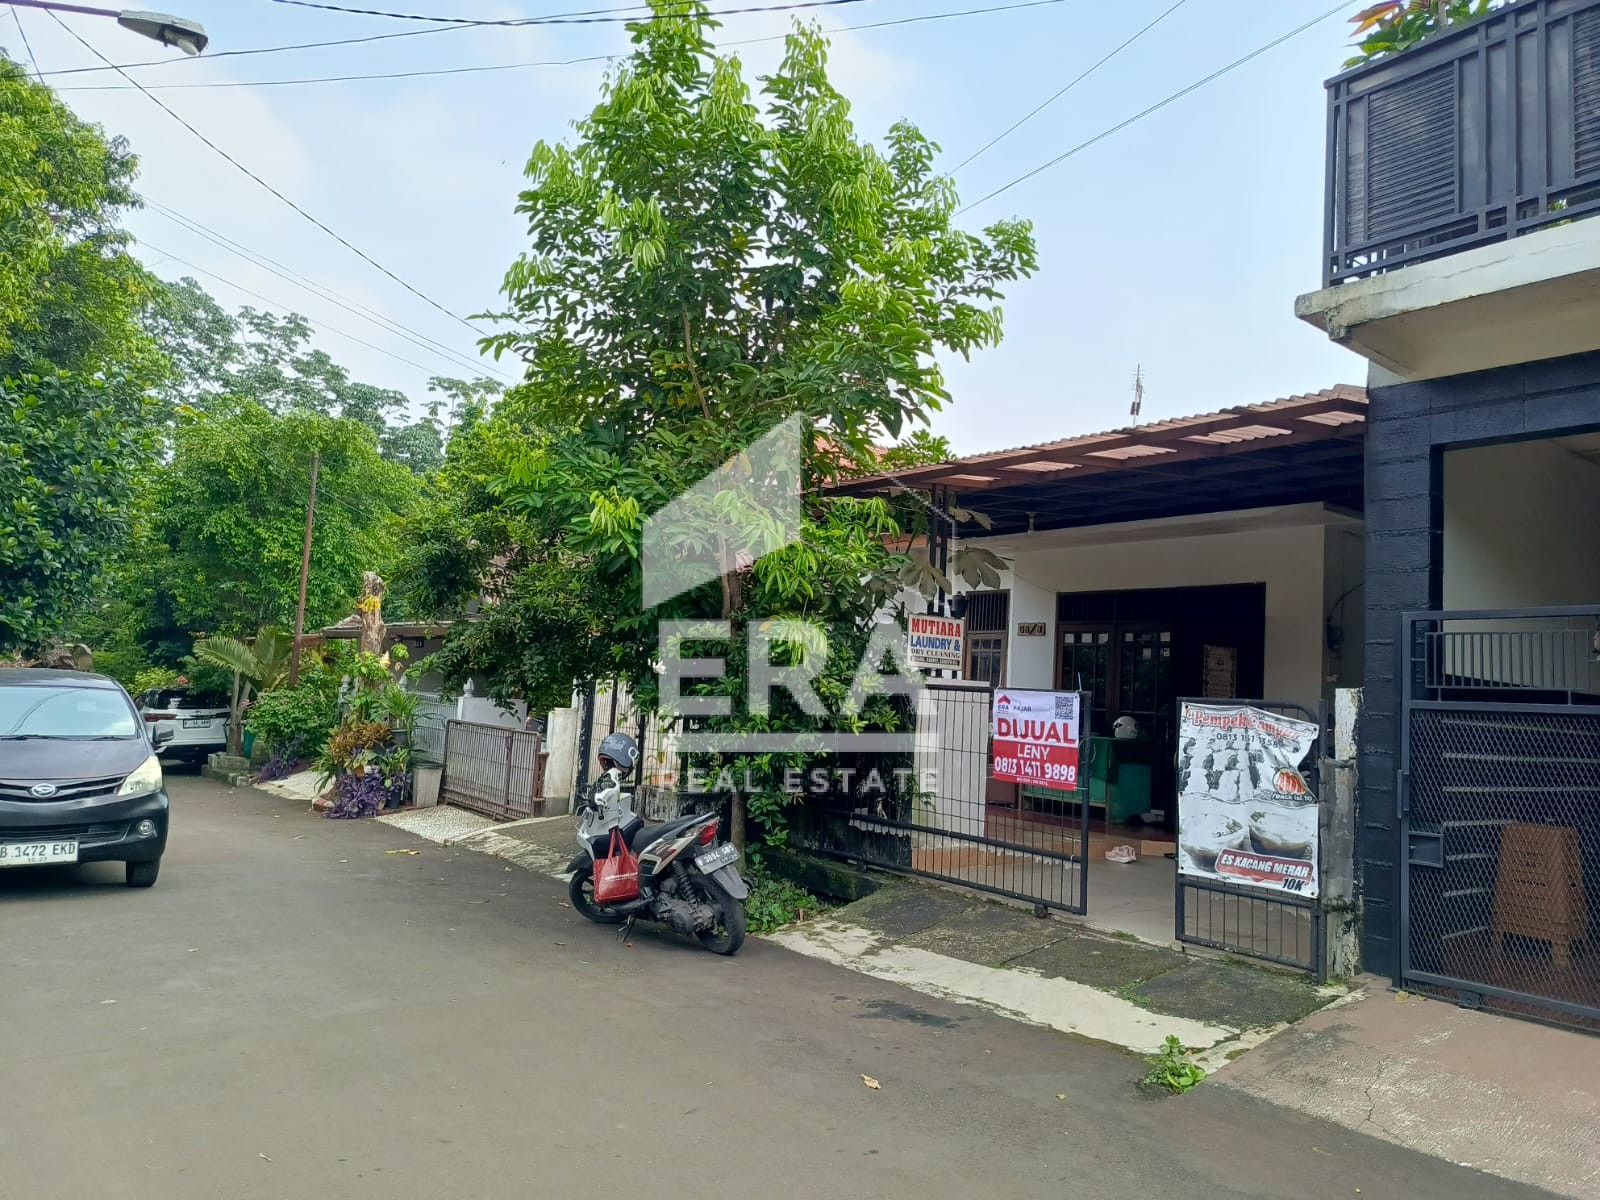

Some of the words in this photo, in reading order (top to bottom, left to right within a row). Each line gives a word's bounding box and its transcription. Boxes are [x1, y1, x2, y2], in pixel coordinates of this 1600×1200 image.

[911, 618, 961, 638] MUTIARA
[911, 635, 952, 650] LAUNDRY
[953, 639, 961, 652] &
[926, 649, 960, 659] CLEANING
[1012, 705, 1032, 713] FAJAR
[997, 717, 1077, 744] DIJUAL
[1216, 732, 1238, 741] 0813
[1017, 743, 1050, 761] LENY
[994, 756, 1017, 774] 0813
[1019, 758, 1041, 777] 1411
[1043, 763, 1076, 782] 9898
[0, 846, 8, 859] B
[15, 845, 46, 858] 1472
[52, 843, 76, 856] EKD
[1221, 854, 1234, 866] ES
[1234, 857, 1273, 874] KACANG
[1273, 862, 1310, 879] MERAH
[1282, 877, 1305, 893] 10K
